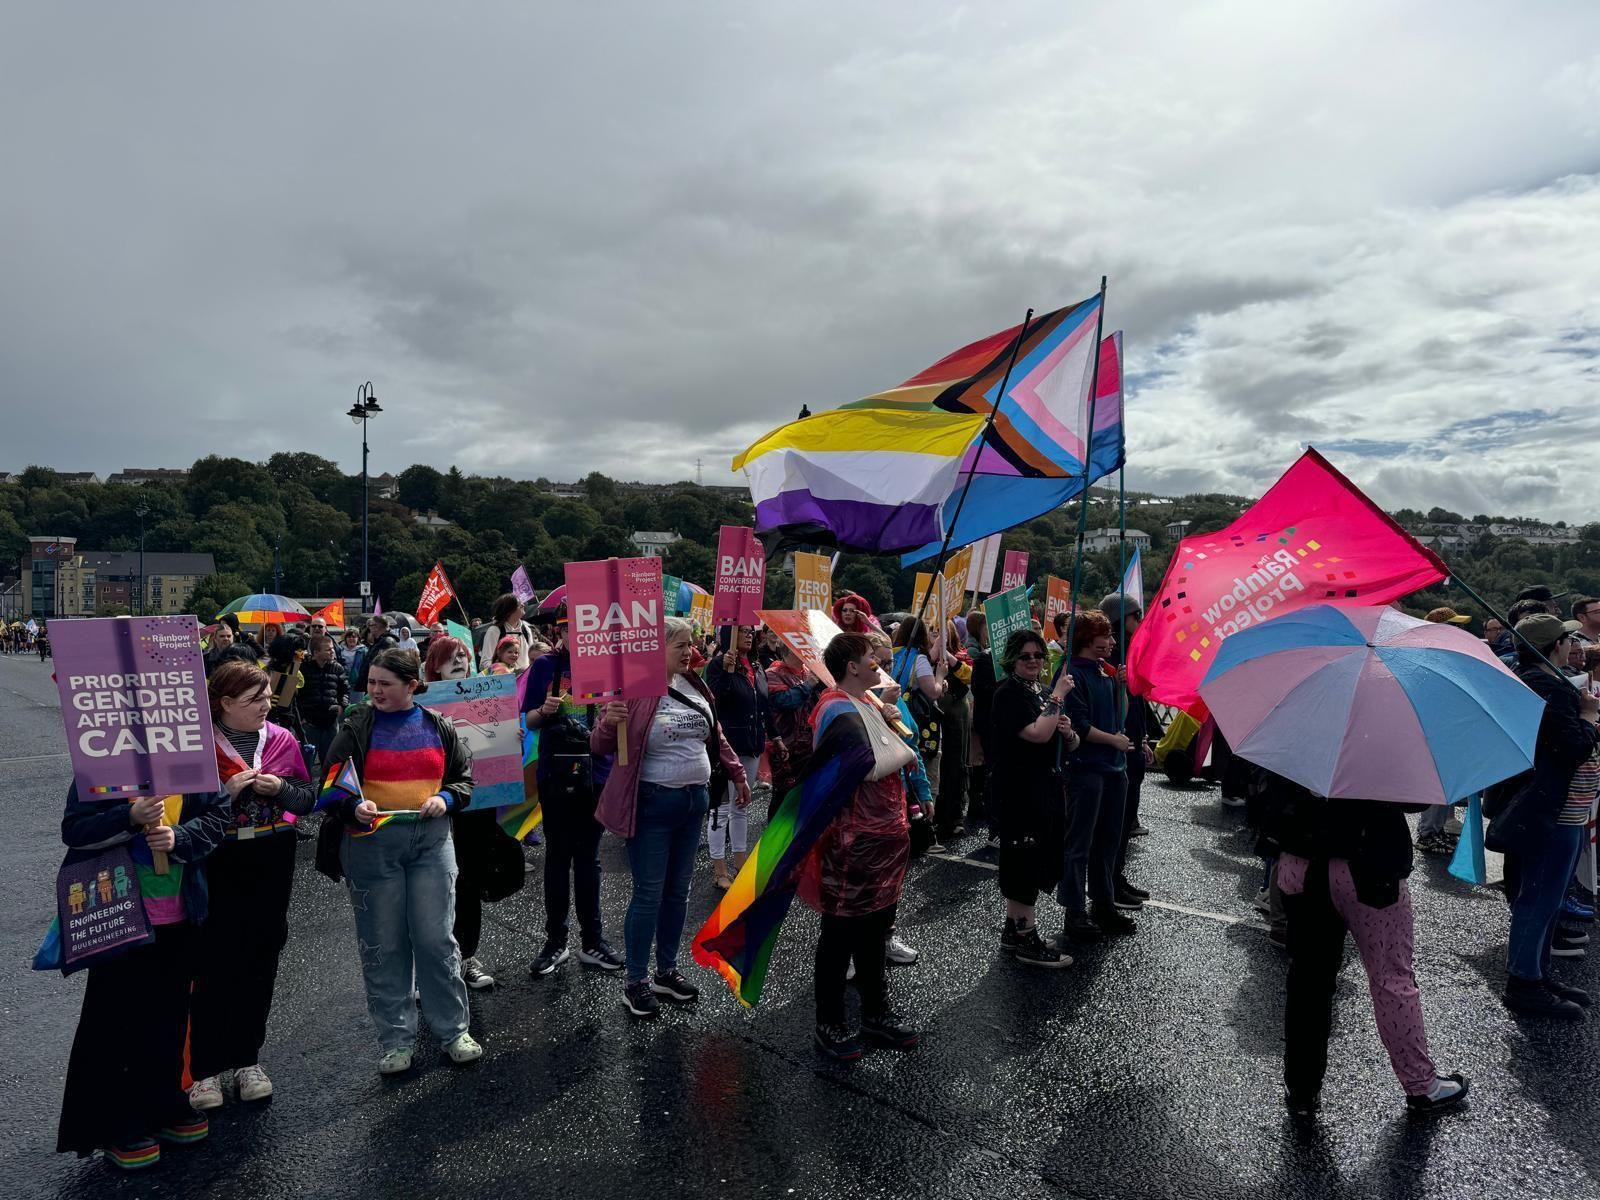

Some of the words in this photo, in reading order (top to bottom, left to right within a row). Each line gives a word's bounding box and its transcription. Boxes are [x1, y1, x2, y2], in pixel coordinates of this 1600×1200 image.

[720, 555, 764, 577] BAN
[718, 584, 761, 594] PRACTICES
[719, 577, 762, 585] CONVERSION
[798, 579, 829, 597] ZERO
[1004, 572, 1025, 587] BAN
[1047, 595, 1067, 613] END
[575, 600, 658, 632] BAN
[991, 609, 1028, 631] DELIVER
[152, 633, 190, 642] Rainbow
[159, 641, 192, 650] Project
[576, 628, 658, 644] CONVERSION
[577, 639, 660, 657] PRACTICES
[69, 670, 195, 690] PRIORITISE
[72, 687, 197, 711] GENDER
[77, 707, 200, 728] AFFIRMING
[78, 724, 204, 758] CARE
[69, 900, 135, 928] ENGINEERING:
[70, 928, 87, 942] THE
[88, 916, 125, 935] FUTURE
